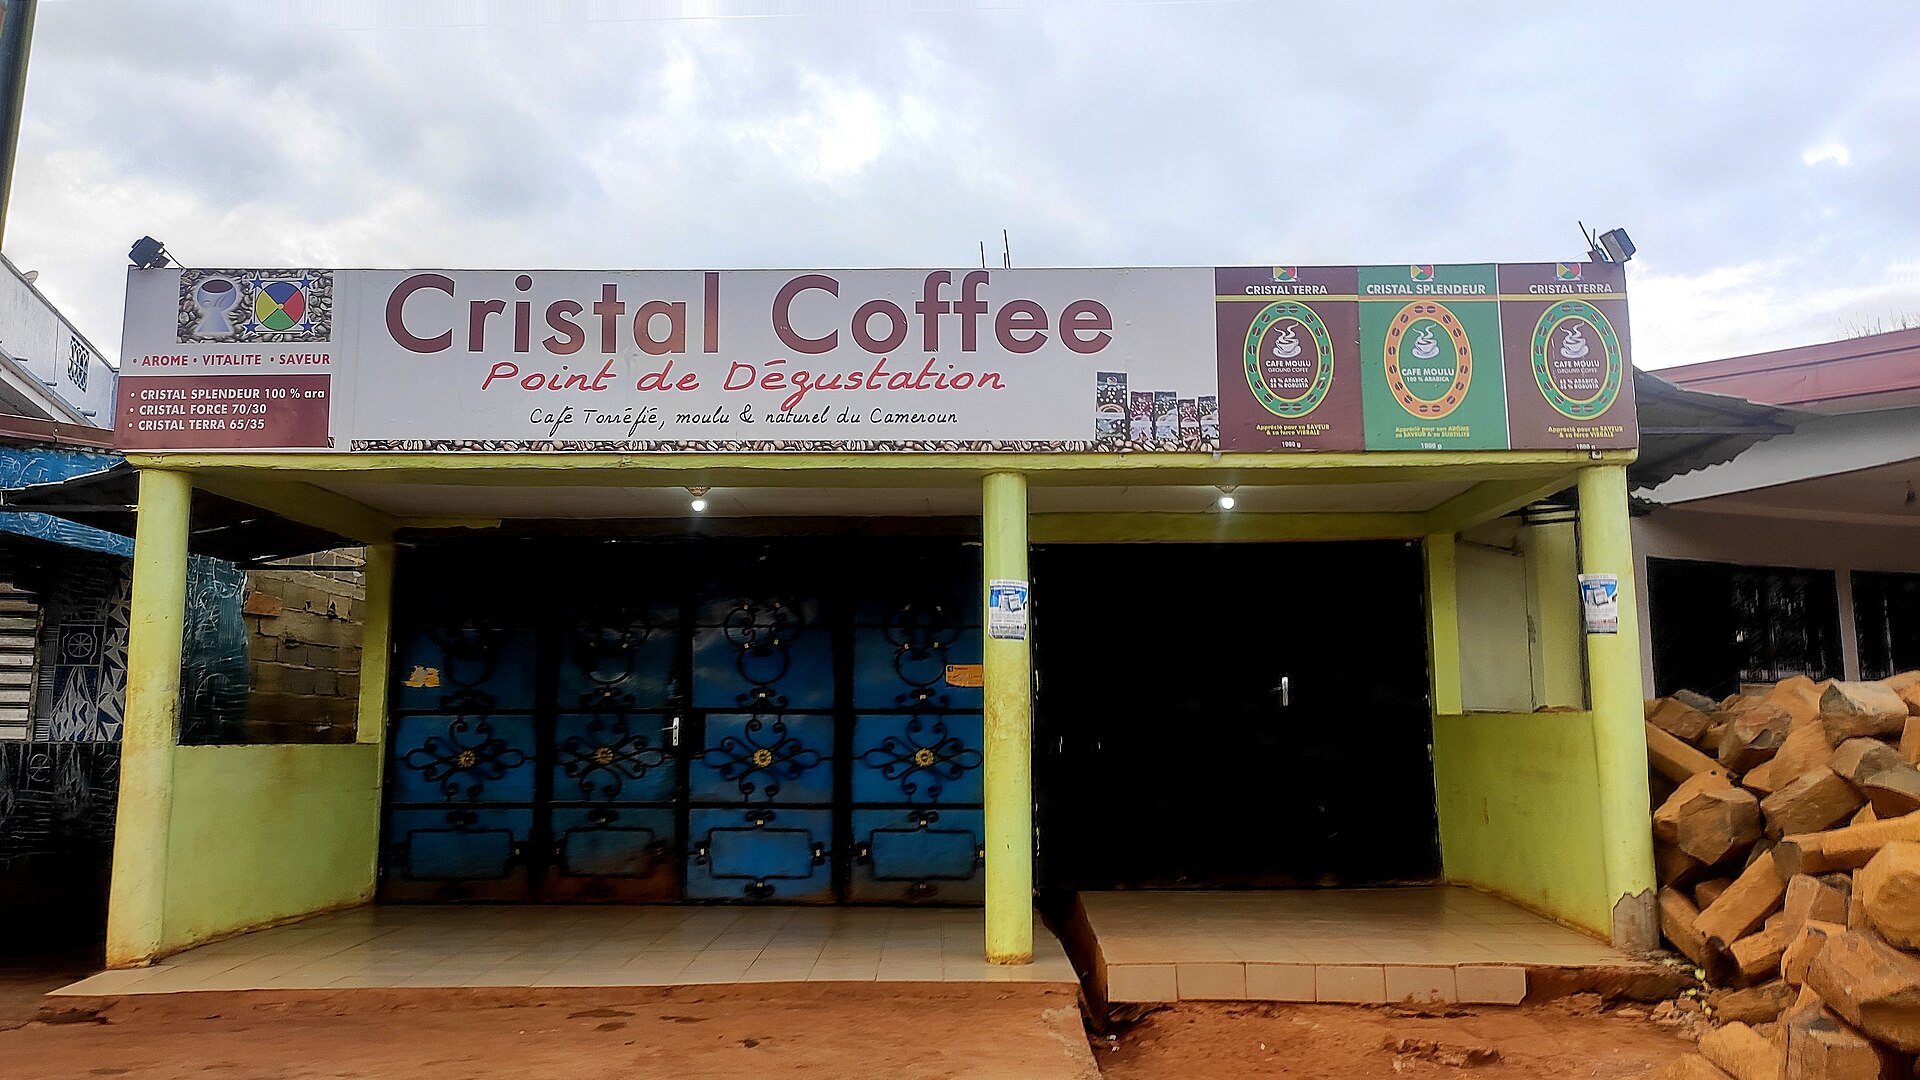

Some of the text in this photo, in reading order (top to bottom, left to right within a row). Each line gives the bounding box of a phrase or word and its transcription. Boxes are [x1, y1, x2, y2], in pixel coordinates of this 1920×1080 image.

[1245, 285, 1328, 294] CRISTAL TERRA
[1366, 284, 1486, 294] CRISTAL SPLENDEUR
[1528, 283, 1613, 294] CRISTAL TERRA
[385, 270, 1113, 354] Cristal Coffee
[142, 354, 330, 366] AROME VITALITE SAVEUR
[1401, 368, 1455, 376] CAFE MOULU
[481, 358, 1005, 412] Point de Dégustation
[140, 388, 326, 400] CRISTAL SPLENDEUR 100 % ara
[138, 403, 267, 416] CRISTAL FORCE 70/30
[138, 418, 265, 431] CRISTAL TERRA 65/35
[530, 405, 574, 438] Café
[675, 405, 730, 424] moulu
[738, 403, 755, 424] &
[765, 405, 831, 424] naturel
[836, 406, 862, 424] du
[870, 407, 958, 424] Cameroun
